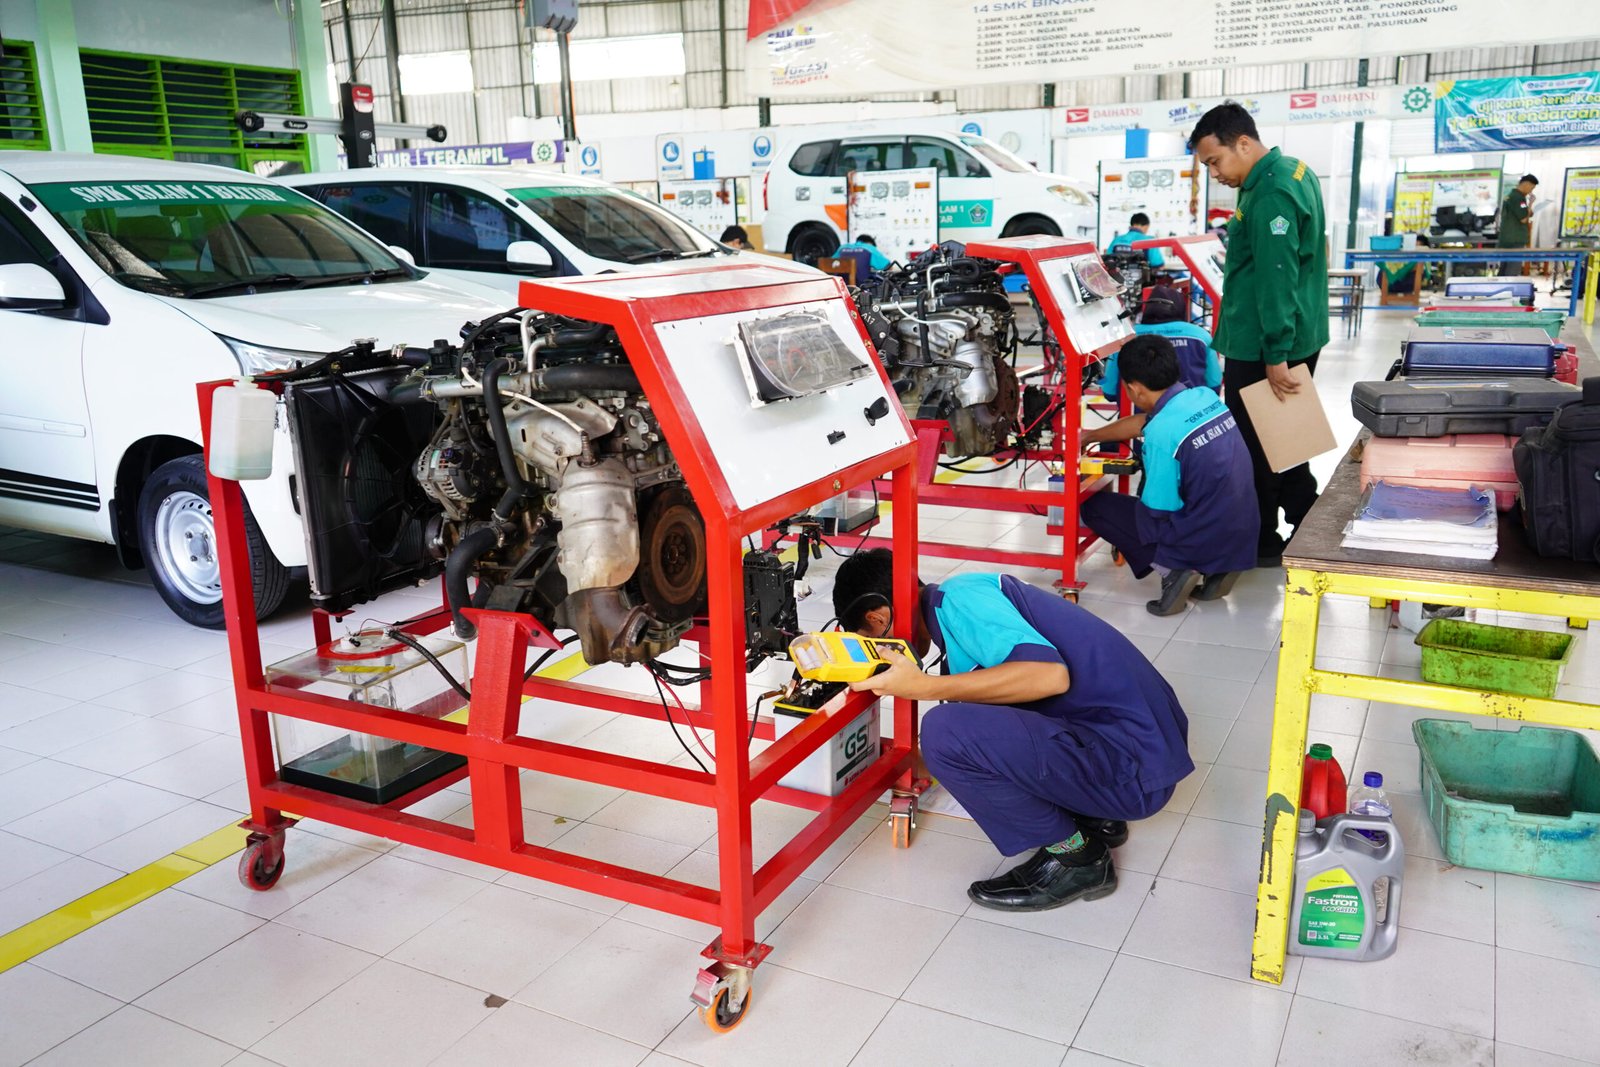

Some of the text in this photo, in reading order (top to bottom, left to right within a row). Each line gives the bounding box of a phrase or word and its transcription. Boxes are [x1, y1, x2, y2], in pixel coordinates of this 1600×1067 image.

[974, 5, 988, 13] 14
[993, 1, 1027, 11] SMK
[1371, 4, 1458, 19] TULUNGAGUNG
[1367, 17, 1428, 28] PASURUAN
[1270, 36, 1313, 45] JEMBER
[1178, 58, 1208, 67] Maret
[1211, 56, 1236, 65] 2021
[1322, 92, 1378, 104] DAIHATSU
[1496, 92, 1575, 110] Kompetensi
[1093, 108, 1143, 119] DAIHATSU
[1168, 105, 1188, 118] SMK
[1451, 108, 1600, 130] Teknik Kendaraan
[423, 146, 509, 166] TERAMPIL
[69, 184, 287, 202] SMK ISLAM 1 BLITAR
[1191, 433, 1209, 450] SMK
[844, 724, 867, 760] GS
[1308, 896, 1358, 907] Fastron
[1322, 906, 1358, 914] ECOGREEN
